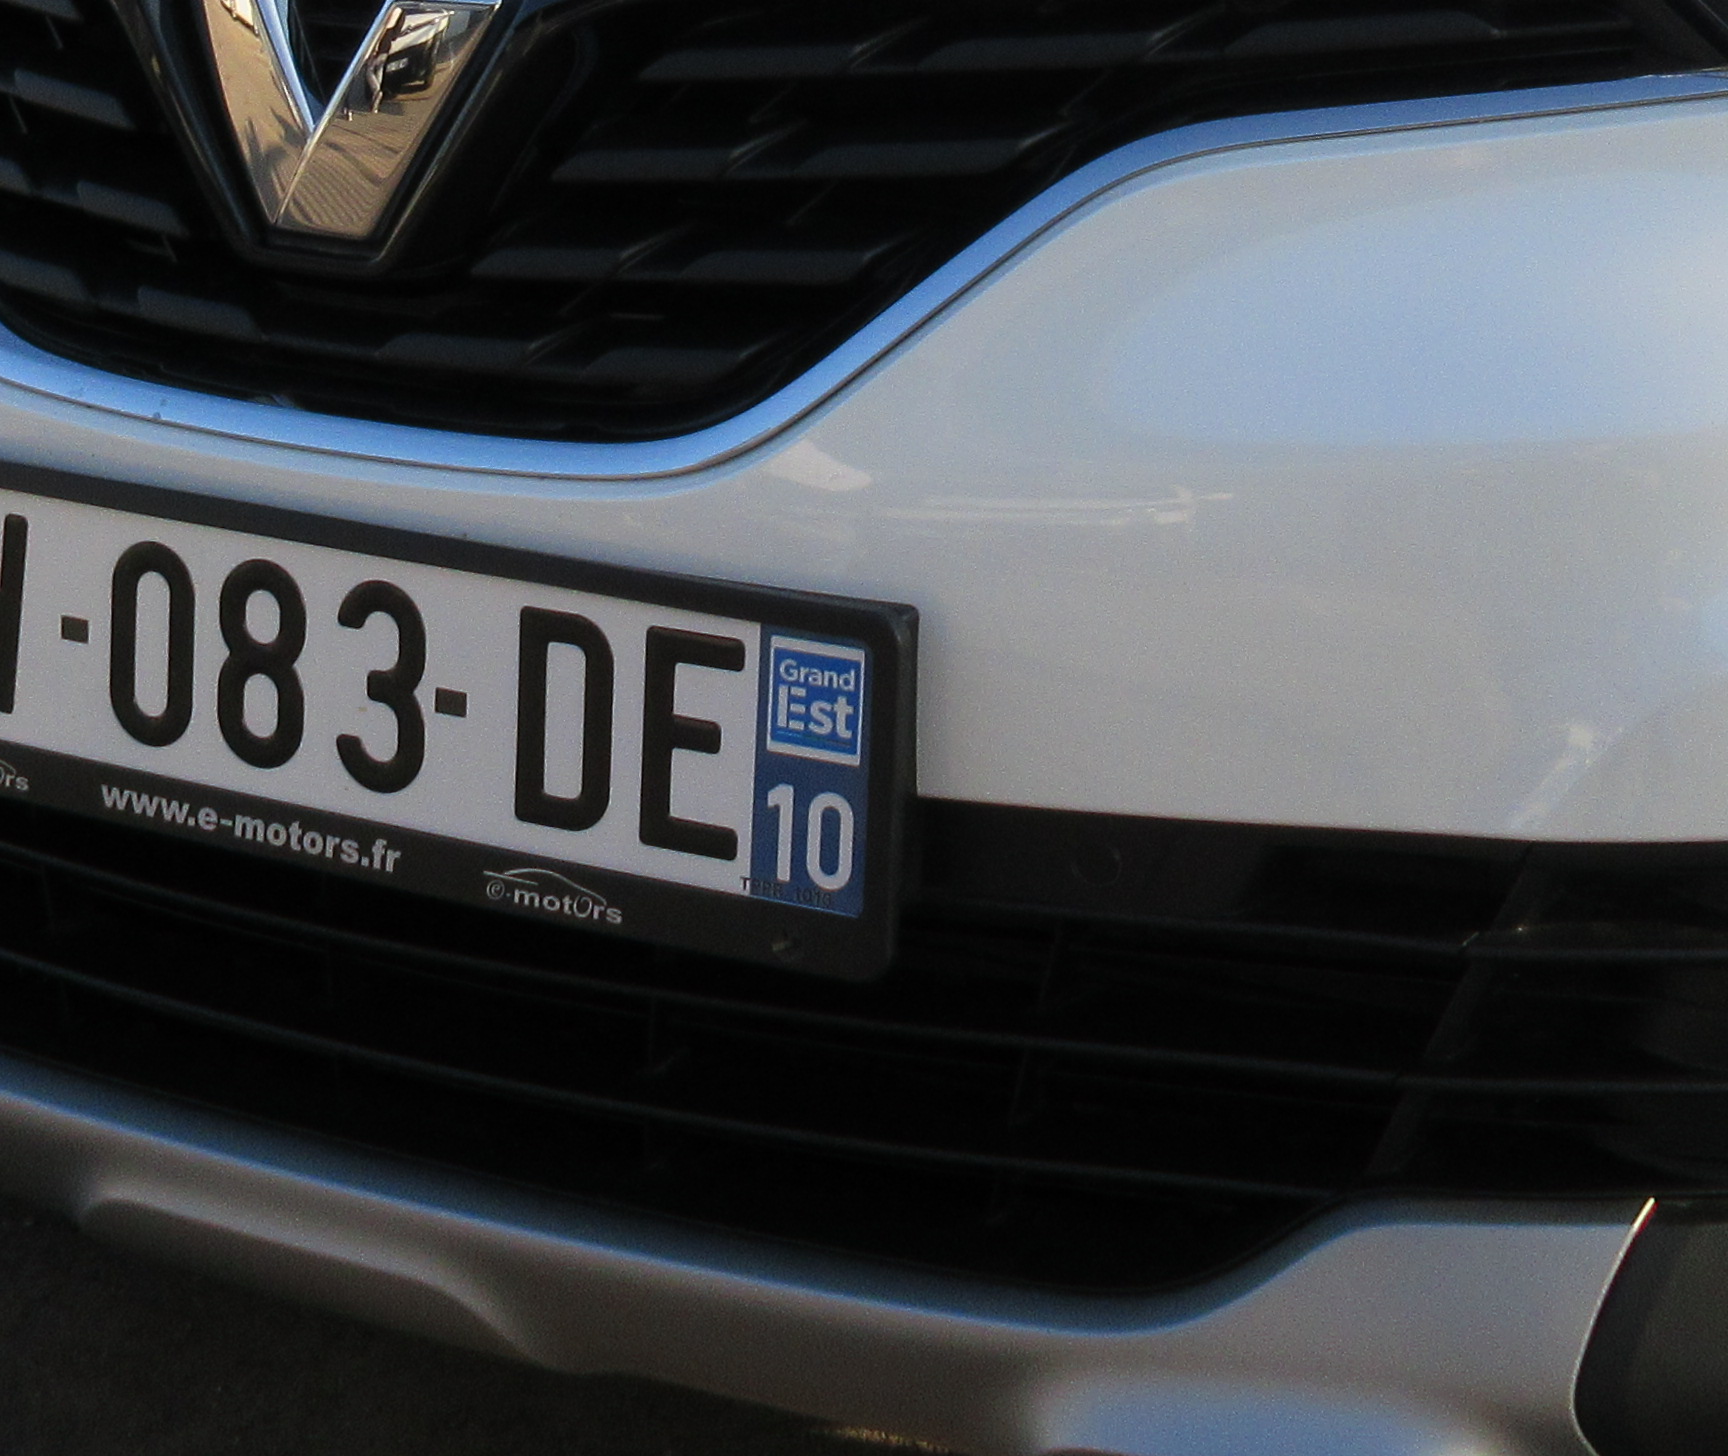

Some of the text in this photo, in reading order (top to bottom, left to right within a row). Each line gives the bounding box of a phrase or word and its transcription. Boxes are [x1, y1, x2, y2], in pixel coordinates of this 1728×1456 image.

[776, 683, 855, 740] Est
[779, 658, 856, 692] Grand
[100, 781, 403, 874] www.e-motors.fr
[767, 782, 855, 892] 10
